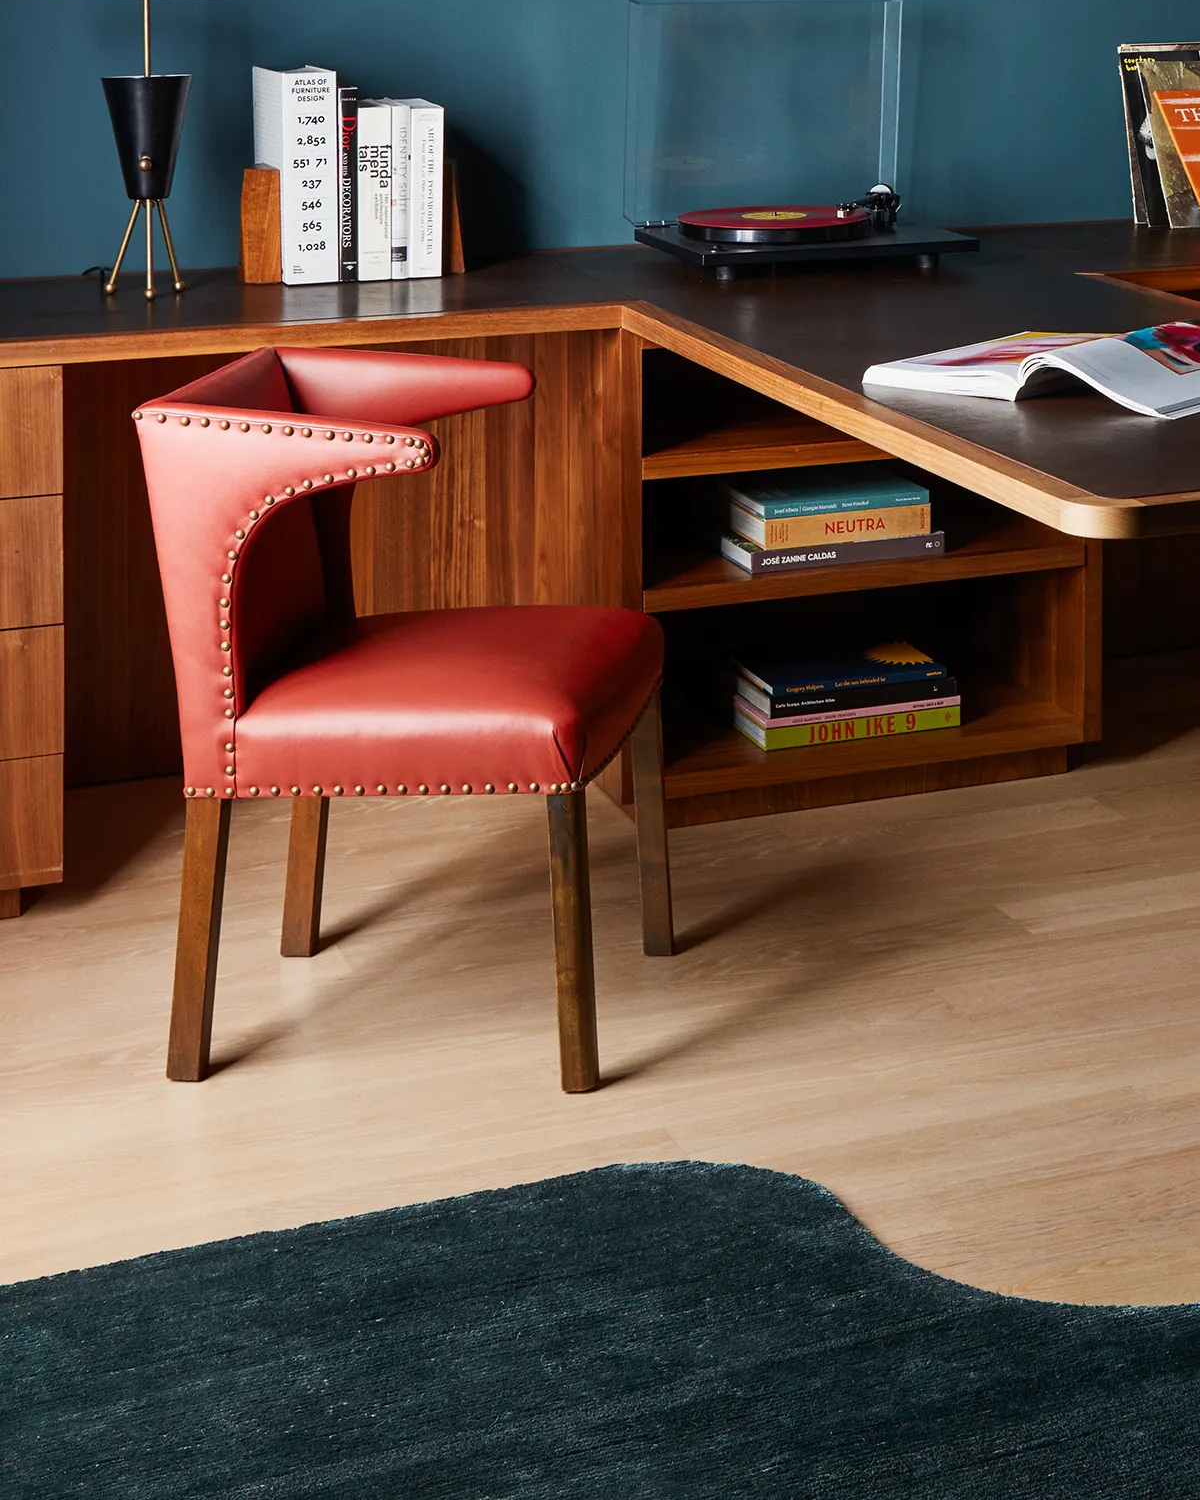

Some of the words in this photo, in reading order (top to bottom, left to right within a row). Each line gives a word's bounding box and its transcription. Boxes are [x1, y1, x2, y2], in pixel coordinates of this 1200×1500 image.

[291, 86, 331, 94] FURNITURE
[297, 115, 326, 126] 1,740
[296, 135, 327, 147] 2,852
[341, 116, 357, 151] Dior
[358, 144, 371, 172] tals
[399, 126, 408, 179] IDENTITY
[428, 144, 434, 156] OF
[293, 158, 310, 169] 551
[315, 158, 327, 168] 71
[369, 145, 380, 179] men
[379, 144, 392, 189] funda
[301, 180, 322, 190] 237
[301, 199, 322, 211] 546
[399, 182, 407, 214] SUITE
[342, 177, 352, 248] DECORATORS
[302, 220, 322, 232] 565
[298, 241, 326, 252] 1,028
[774, 507, 785, 515] Josef
[824, 517, 886, 535] NEUTRA
[761, 556, 780, 567] JOSÉ
[781, 554, 807, 564] ZANINE
[807, 551, 837, 561] CALDAS
[786, 685, 806, 693] Gregory
[859, 676, 880, 685] beheaded
[809, 720, 856, 744] JOHN
[866, 715, 897, 737] IKE
[905, 713, 917, 731] 9
